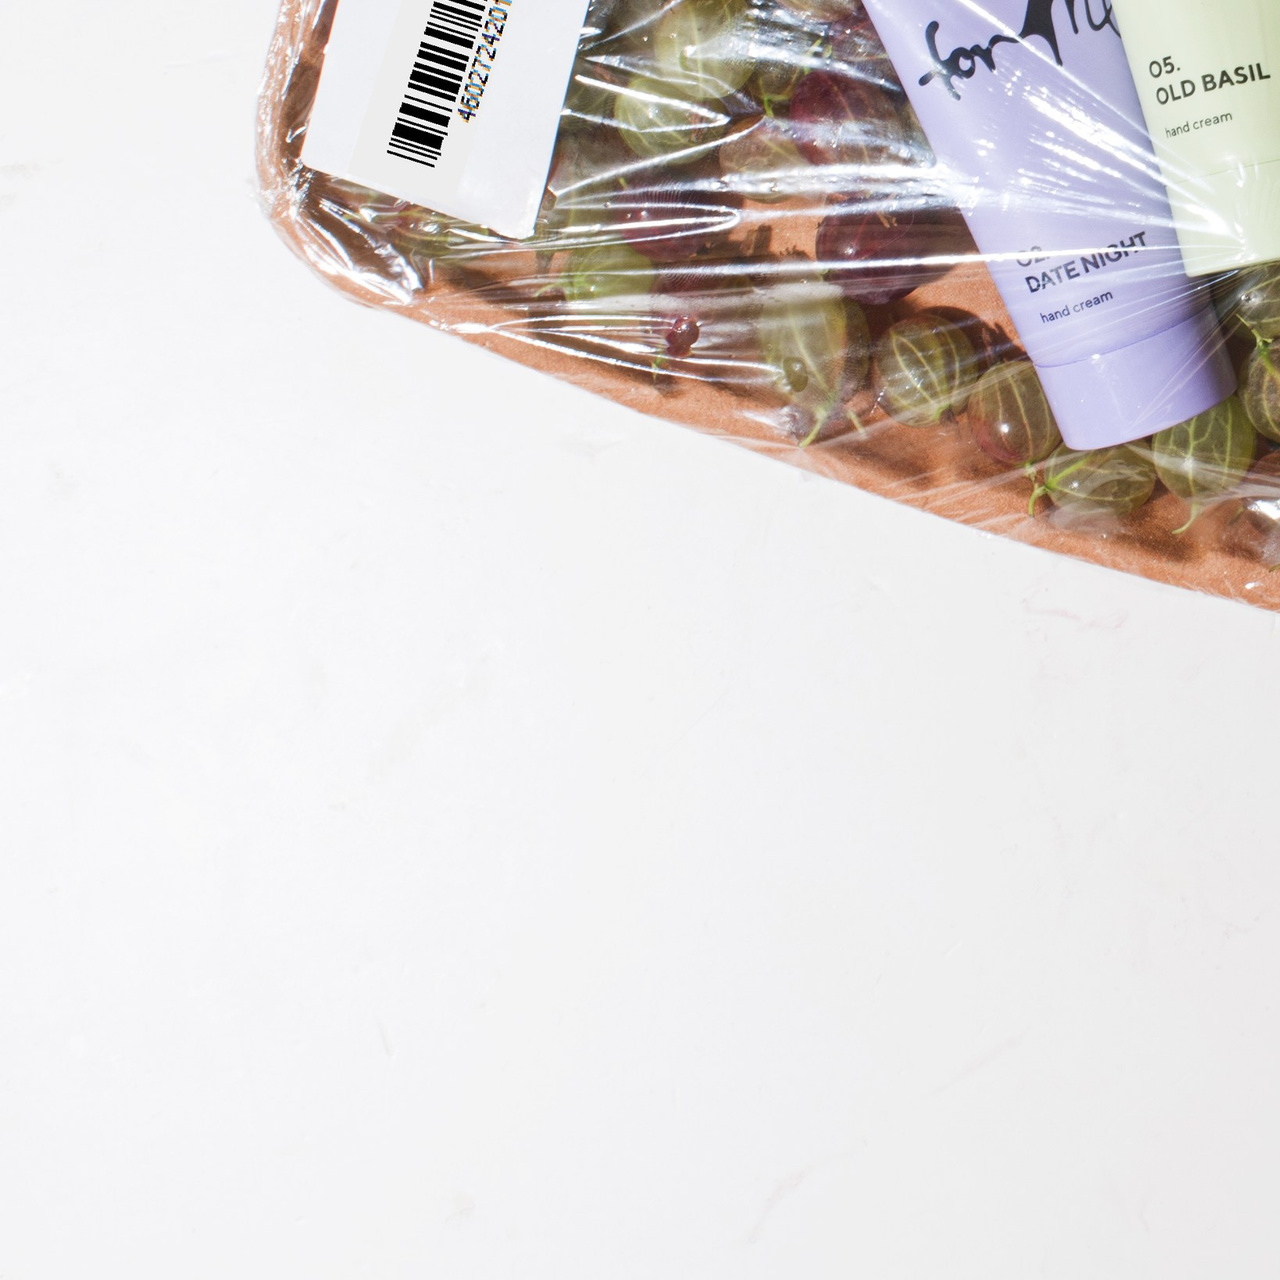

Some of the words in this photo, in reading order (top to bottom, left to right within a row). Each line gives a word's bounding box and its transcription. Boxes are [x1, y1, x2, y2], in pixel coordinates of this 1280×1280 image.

[1156, 79, 1196, 105] OLD
[1201, 62, 1271, 92] BASIL
[1164, 120, 1190, 139] hand
[1192, 111, 1233, 131] cream
[1025, 260, 1080, 293] DATE
[1080, 231, 1146, 273] NIGHT
[1040, 305, 1071, 323] hand
[1073, 290, 1114, 313] cream
